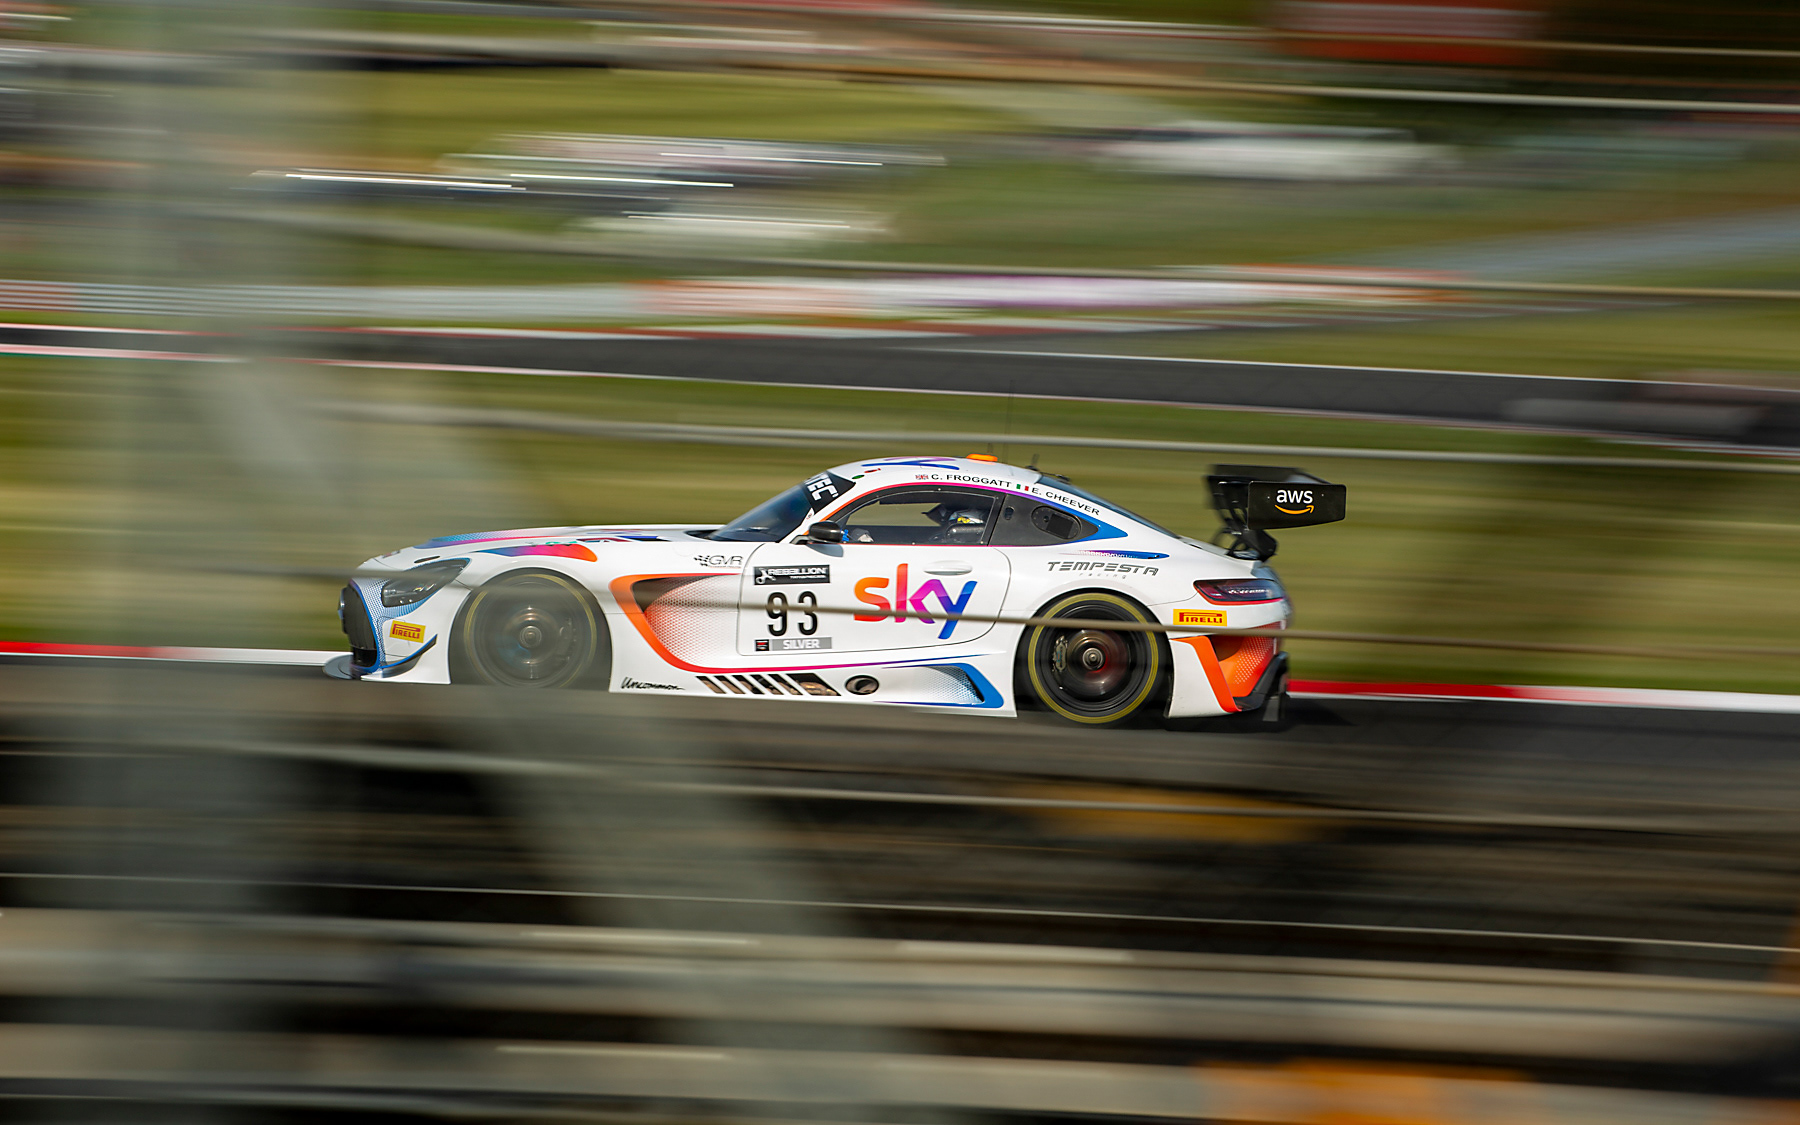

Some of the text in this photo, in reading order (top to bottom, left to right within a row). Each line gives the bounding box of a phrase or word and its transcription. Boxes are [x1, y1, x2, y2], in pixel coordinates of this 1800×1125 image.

[931, 473, 1012, 488] C. FROGGATT
[1031, 487, 1100, 516] E. CHEEVER
[1276, 489, 1313, 504] aws
[767, 567, 827, 576] REBELLION
[1047, 561, 1159, 576] TEMPESTA
[853, 563, 978, 640] sky
[765, 591, 818, 637] 93
[1179, 612, 1223, 624] PIRELLI
[392, 623, 421, 639] PIRELLI
[783, 639, 821, 650] SILVER
